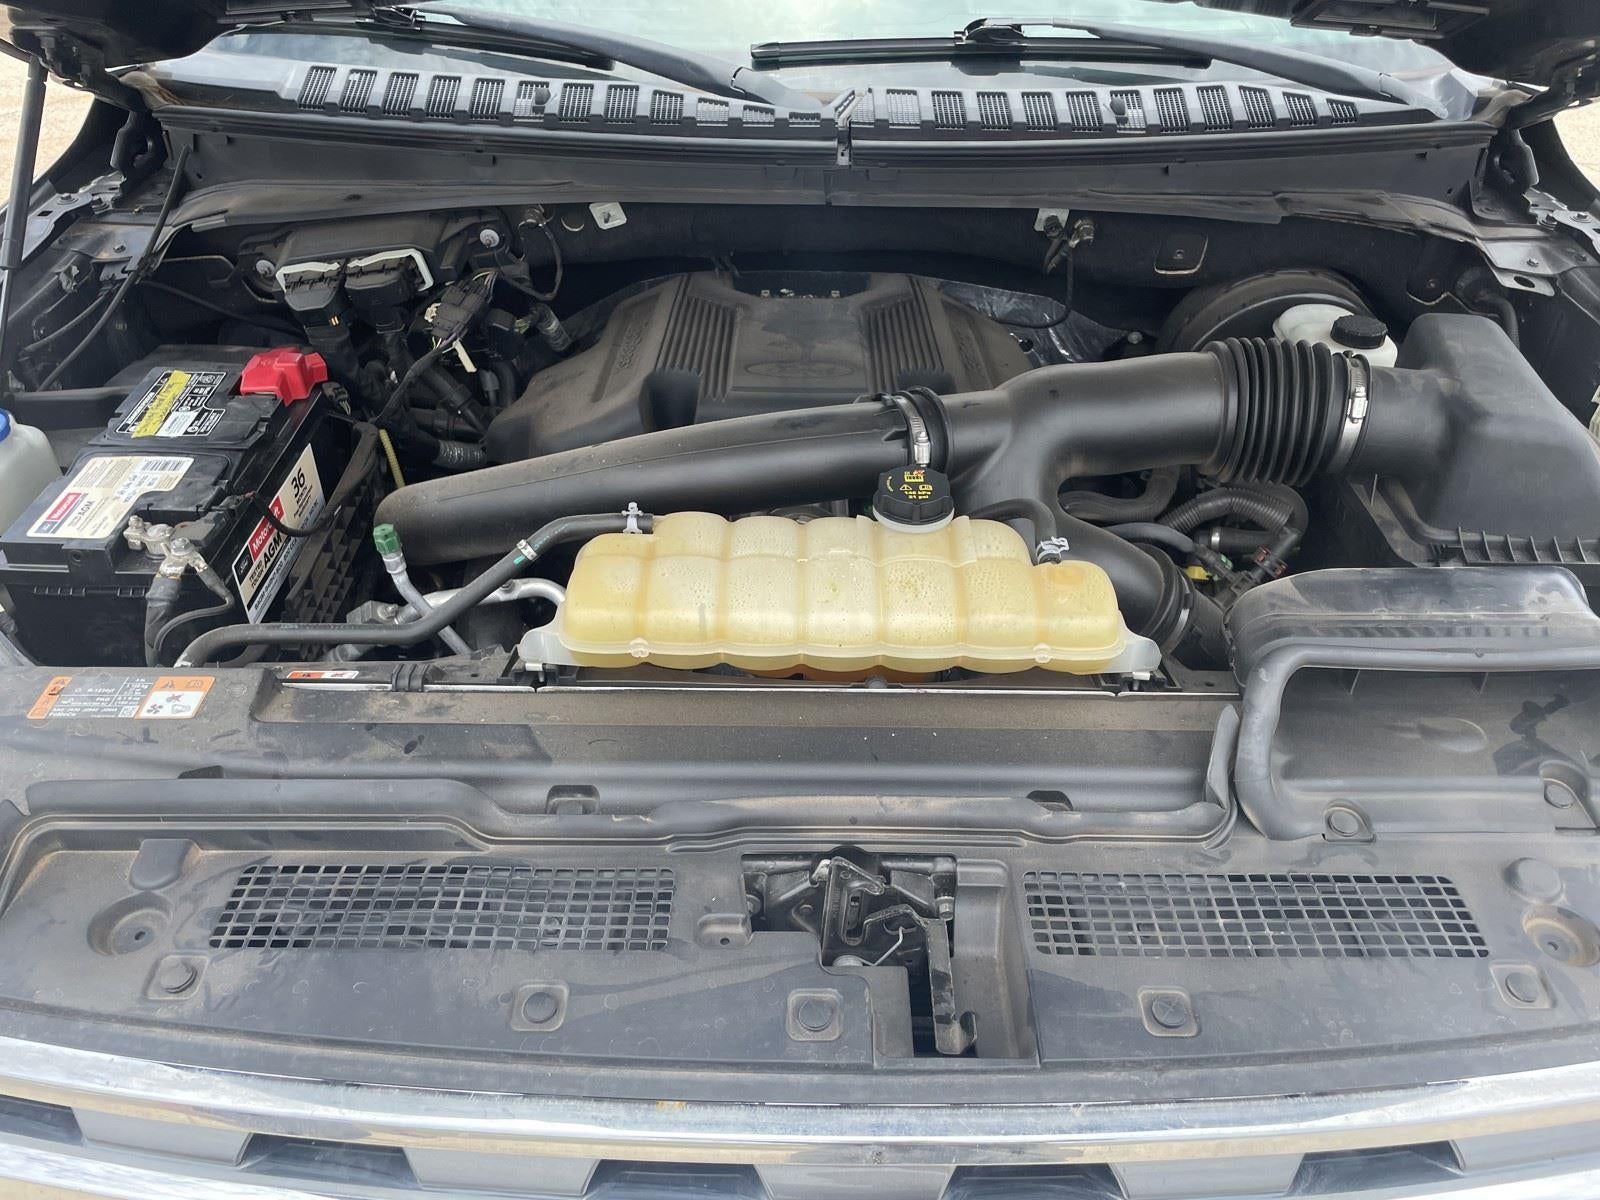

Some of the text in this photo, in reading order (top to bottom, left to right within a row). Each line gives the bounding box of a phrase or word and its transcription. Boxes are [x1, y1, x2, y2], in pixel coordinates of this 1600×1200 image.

[292, 467, 306, 498] 36
[252, 506, 281, 553] Motorcft
[263, 530, 282, 568] AGM
